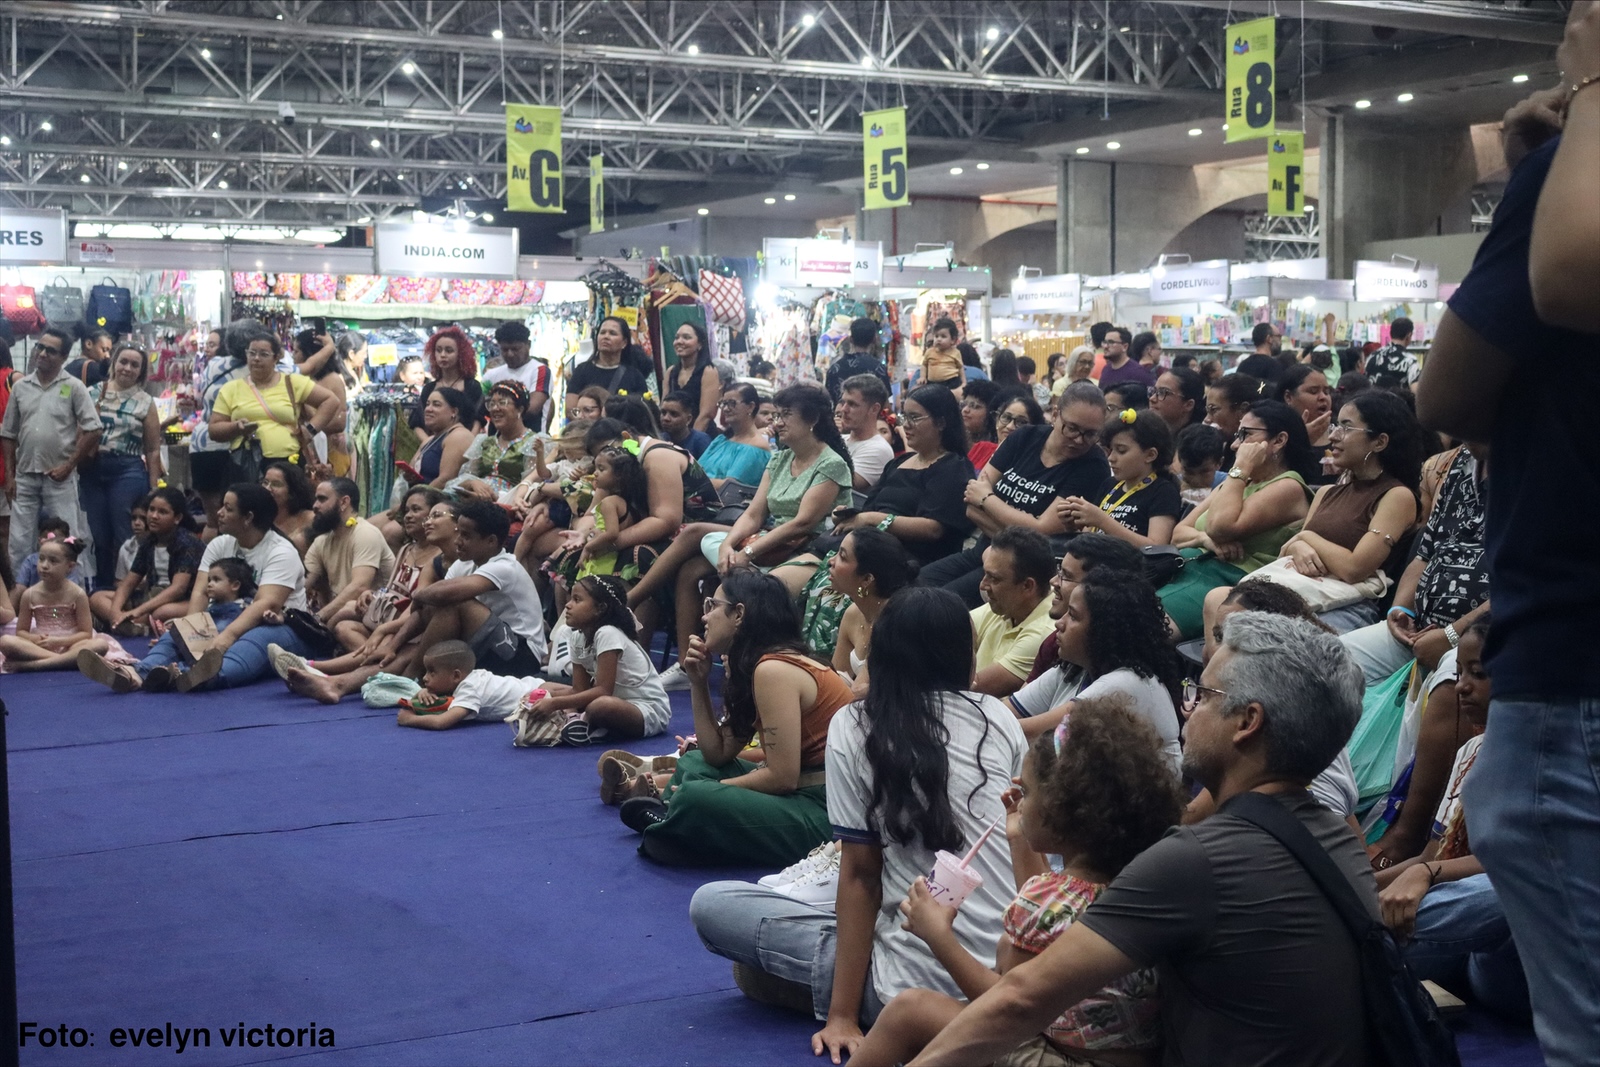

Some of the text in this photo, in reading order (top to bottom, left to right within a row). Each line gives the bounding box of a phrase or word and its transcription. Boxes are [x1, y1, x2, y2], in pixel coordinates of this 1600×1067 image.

[1230, 62, 1273, 129] Rua 8
[511, 165, 529, 181] Av.
[529, 149, 560, 208] G
[868, 147, 906, 202] Rua 5
[1272, 166, 1301, 211] Av. F
[0, 230, 44, 247] RES
[404, 244, 485, 260] INDIA.COM
[1160, 277, 1221, 291] CORDELIVROS
[1371, 277, 1428, 289] RDELIVROS
[1017, 292, 1039, 301] AFEITO
